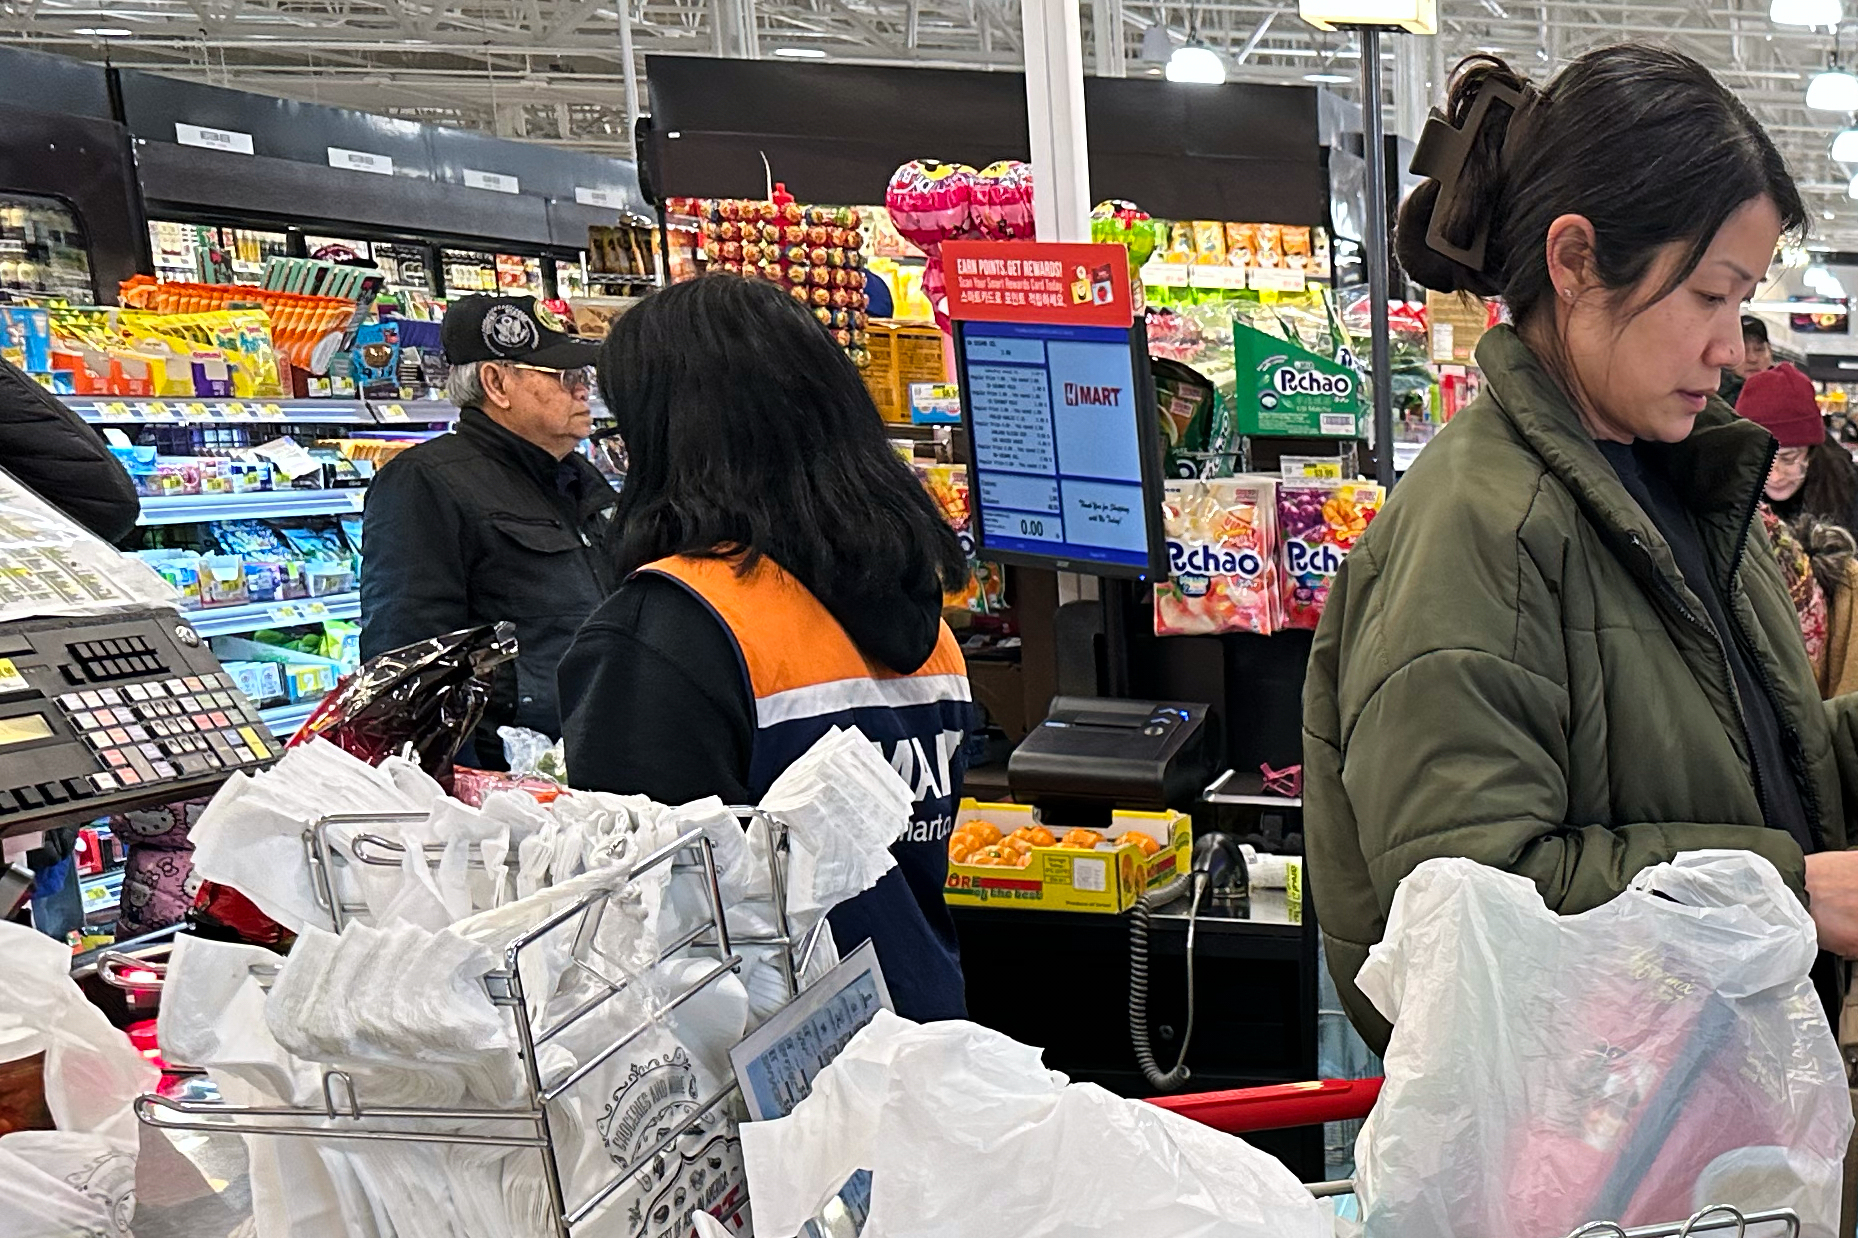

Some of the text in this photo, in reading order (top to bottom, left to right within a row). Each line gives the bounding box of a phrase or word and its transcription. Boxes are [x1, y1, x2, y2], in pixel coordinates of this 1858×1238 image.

[957, 259, 977, 275] EARN
[1023, 260, 1063, 278] REWARDS!
[1080, 386, 1122, 406] MART
[1021, 519, 1043, 537] 0.00
[1287, 541, 1341, 572] Puch
[990, 887, 1011, 900] the
[1013, 888, 1043, 900] best
